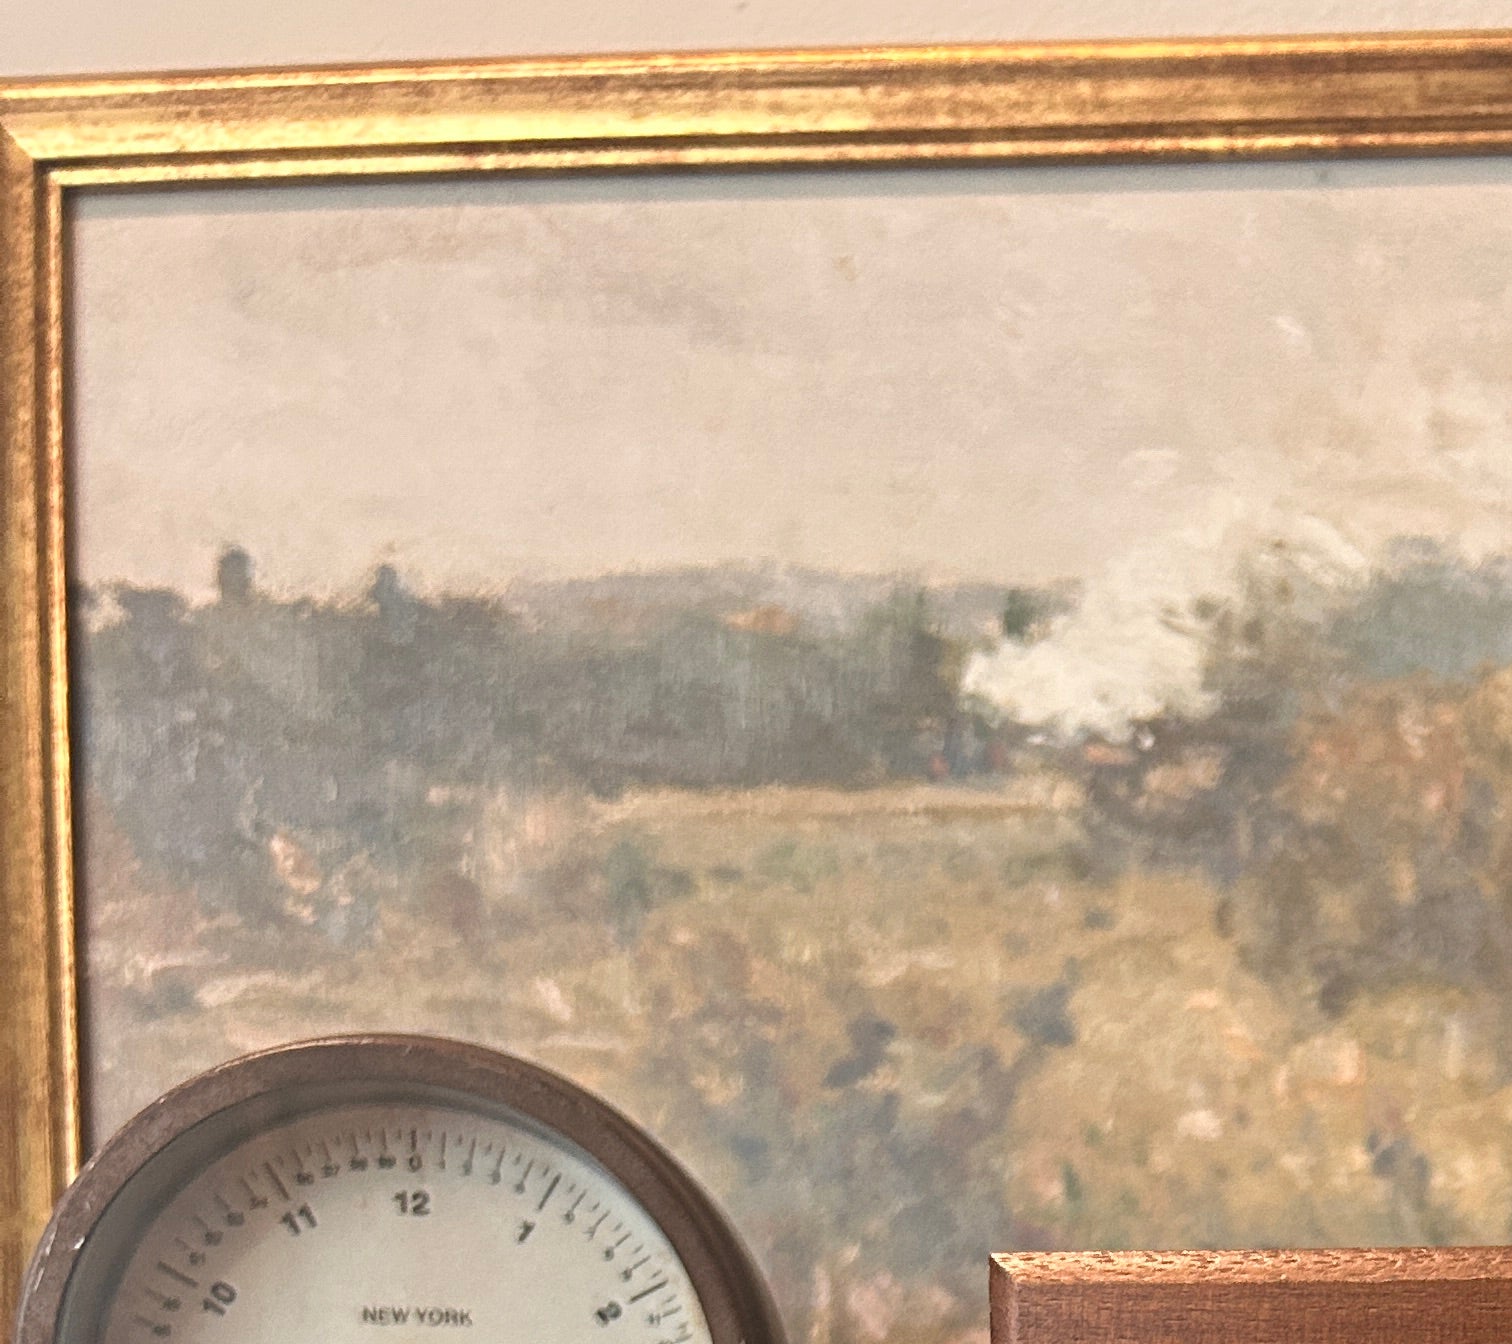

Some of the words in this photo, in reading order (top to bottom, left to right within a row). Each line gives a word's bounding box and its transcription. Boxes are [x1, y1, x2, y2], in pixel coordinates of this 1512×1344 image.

[394, 1189, 431, 1216] 12
[280, 1203, 317, 1236] 11
[515, 1219, 536, 1244] 1
[203, 1280, 238, 1317] 10
[362, 1306, 409, 1327] NEW
[414, 1306, 473, 1327] YORK
